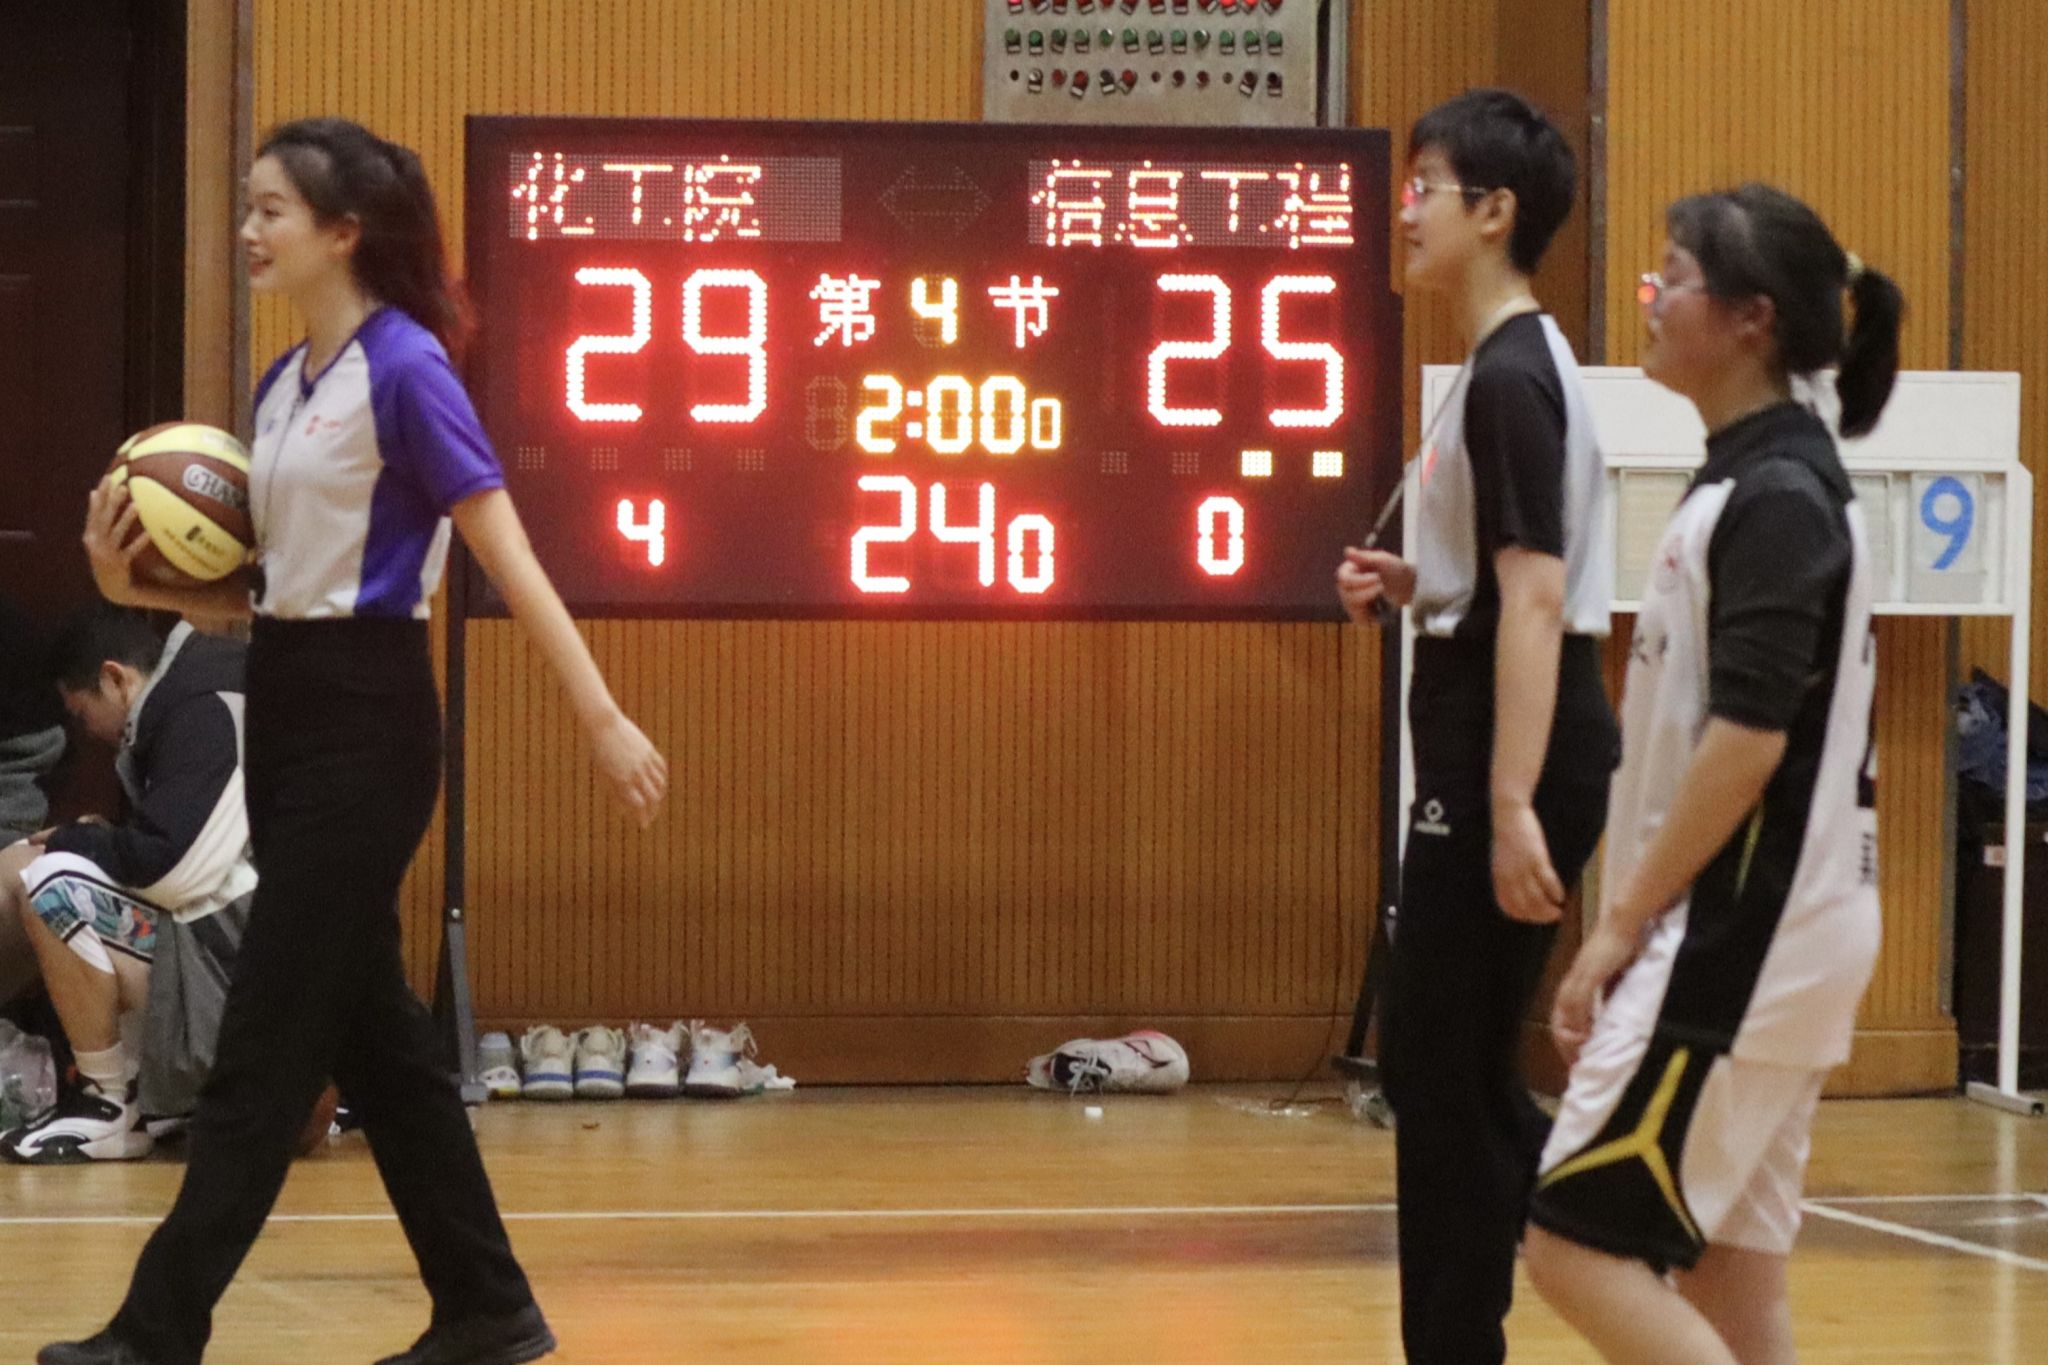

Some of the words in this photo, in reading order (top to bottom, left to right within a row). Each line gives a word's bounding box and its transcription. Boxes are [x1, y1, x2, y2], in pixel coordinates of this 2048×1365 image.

[564, 266, 769, 424] 29
[1147, 273, 1345, 429] 25
[616, 498, 667, 568] 4
[1196, 495, 1246, 577] 0
[1920, 475, 1974, 570] 9
